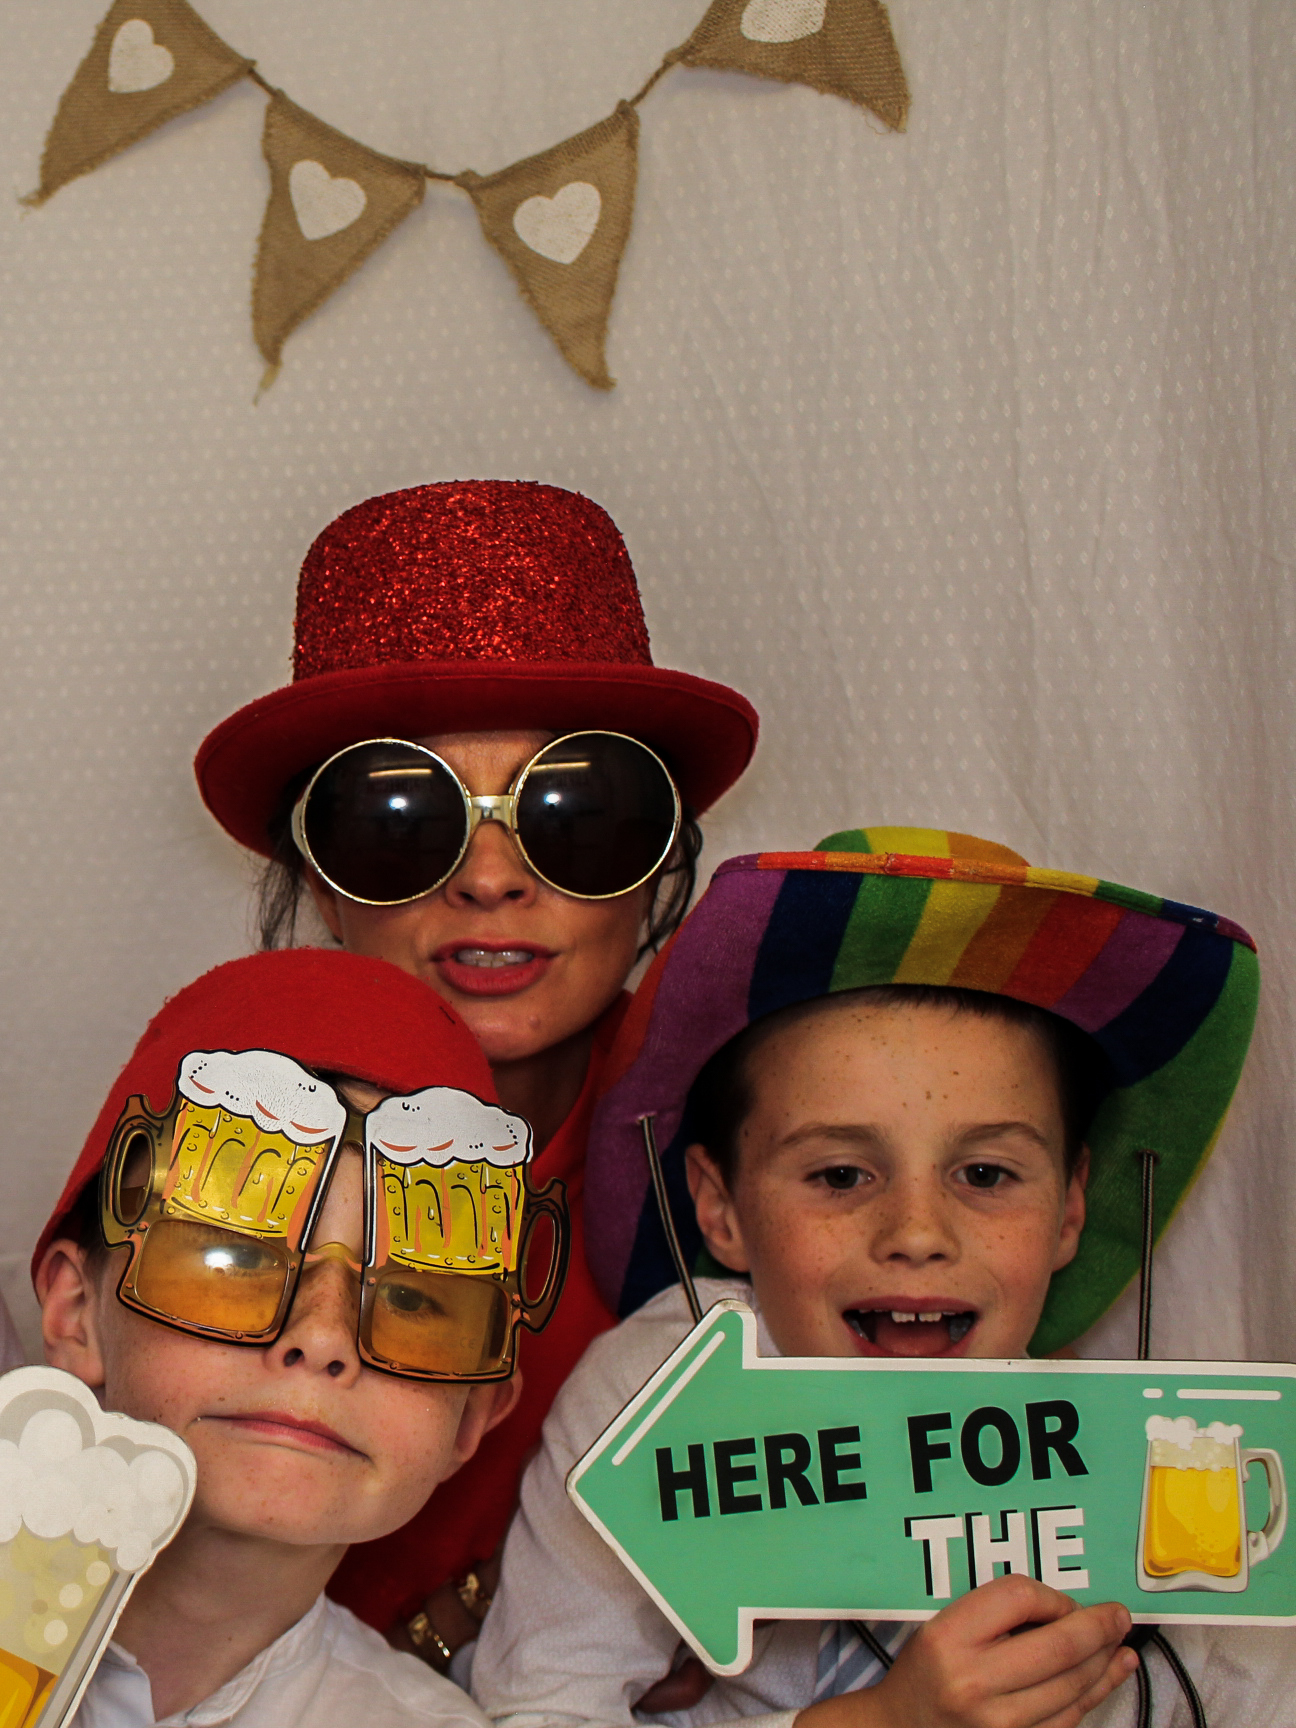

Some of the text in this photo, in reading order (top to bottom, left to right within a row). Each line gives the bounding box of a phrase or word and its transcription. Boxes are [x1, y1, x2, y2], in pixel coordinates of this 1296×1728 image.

[656, 1400, 1090, 1521] HERE FOR
[904, 1505, 1090, 1599] THE
